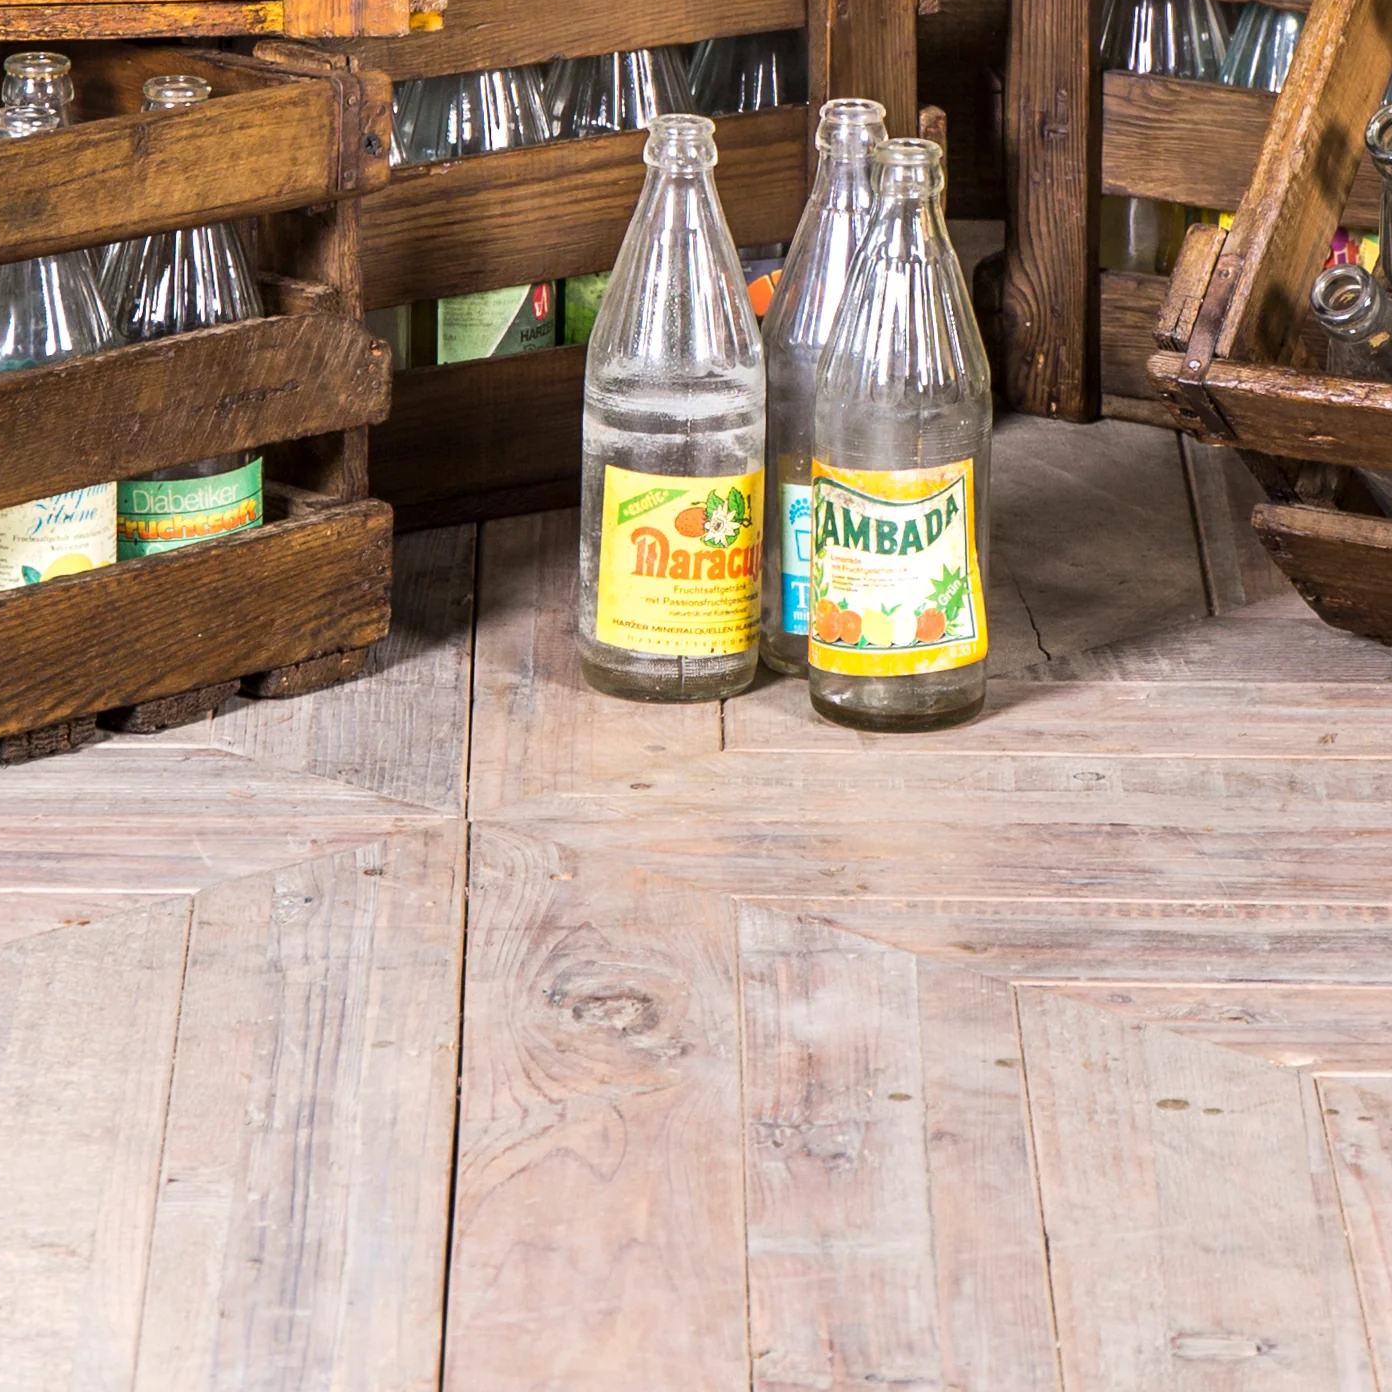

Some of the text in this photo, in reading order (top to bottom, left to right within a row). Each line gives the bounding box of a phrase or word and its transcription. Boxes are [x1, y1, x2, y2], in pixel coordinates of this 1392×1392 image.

[132, 483, 239, 514] Diabetiker
[645, 596, 660, 605] mit
[937, 578, 962, 607] Grün
[612, 617, 649, 631] HARZER
[652, 625, 733, 635] MINERALQUELLEN
